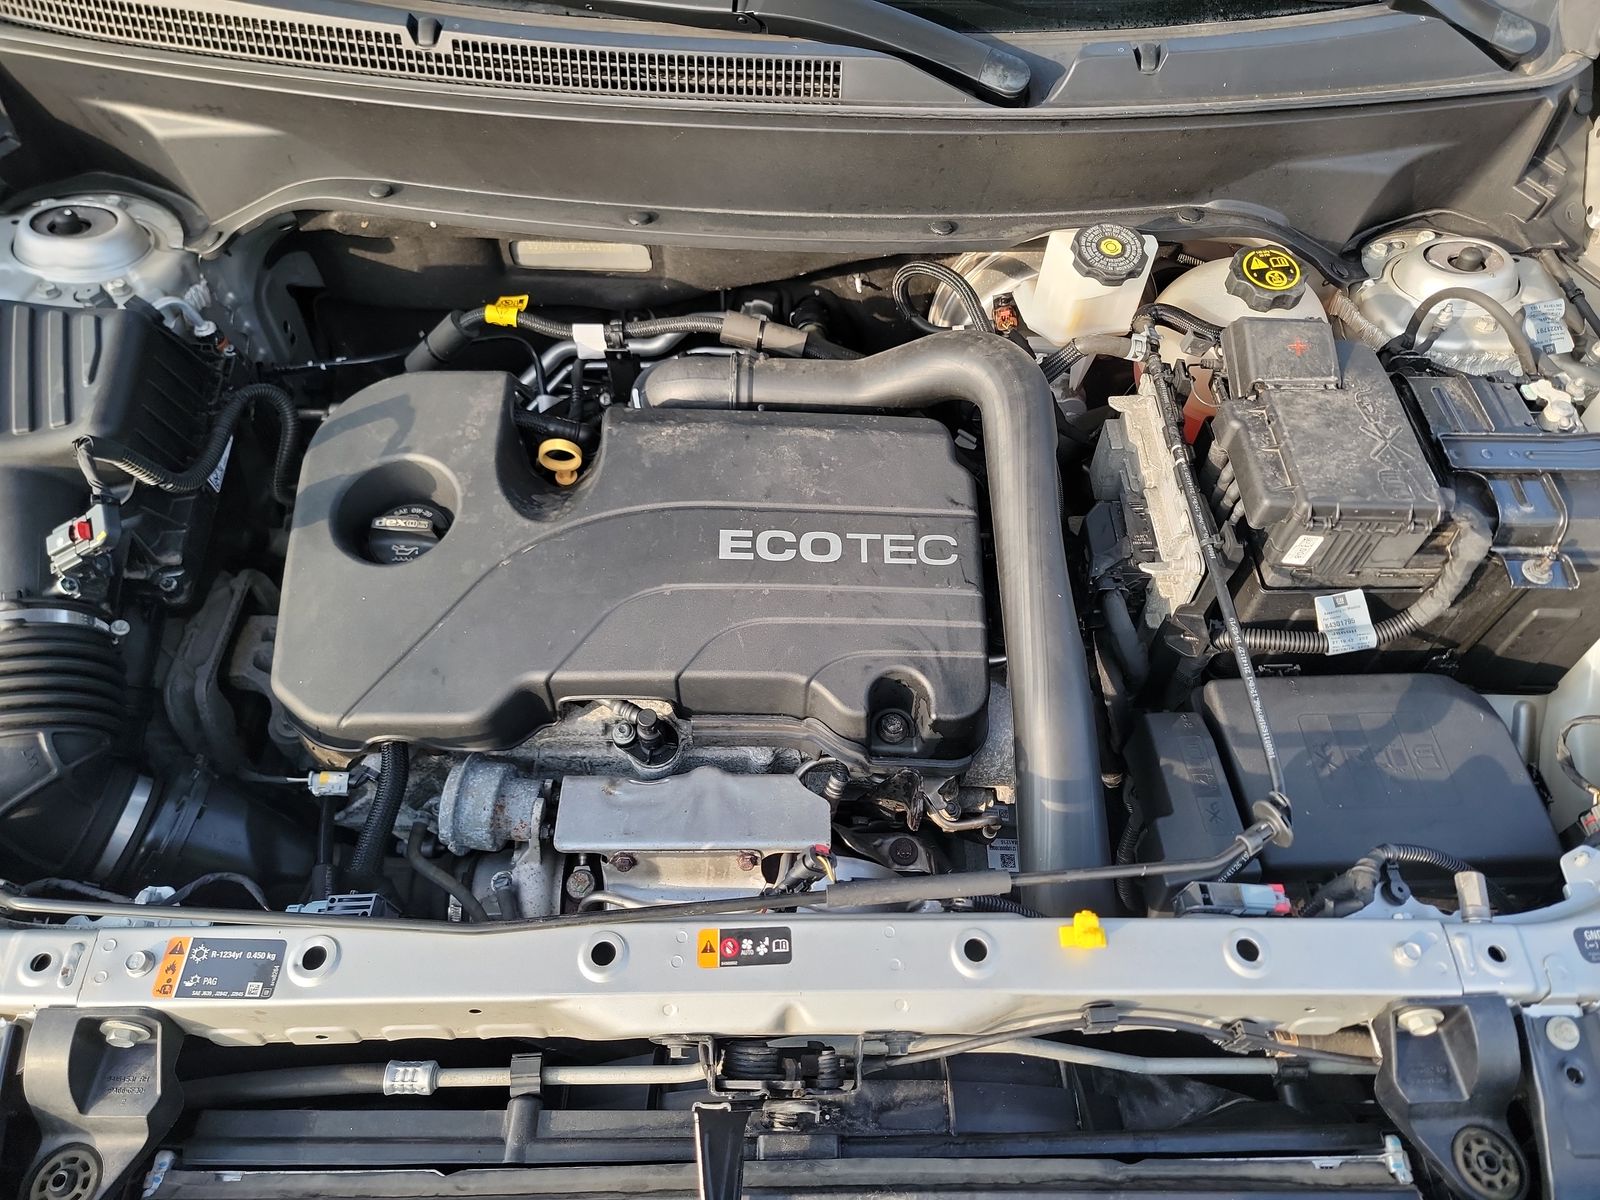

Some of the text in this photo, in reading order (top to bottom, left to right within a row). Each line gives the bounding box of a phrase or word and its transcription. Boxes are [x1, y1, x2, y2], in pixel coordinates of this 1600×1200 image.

[394, 508, 408, 516] SAE
[375, 518, 429, 529] dexos
[718, 529, 959, 566] ECOTEC
[210, 951, 277, 961] R-1234yf 0.450 kg
[202, 977, 218, 986] PAG
